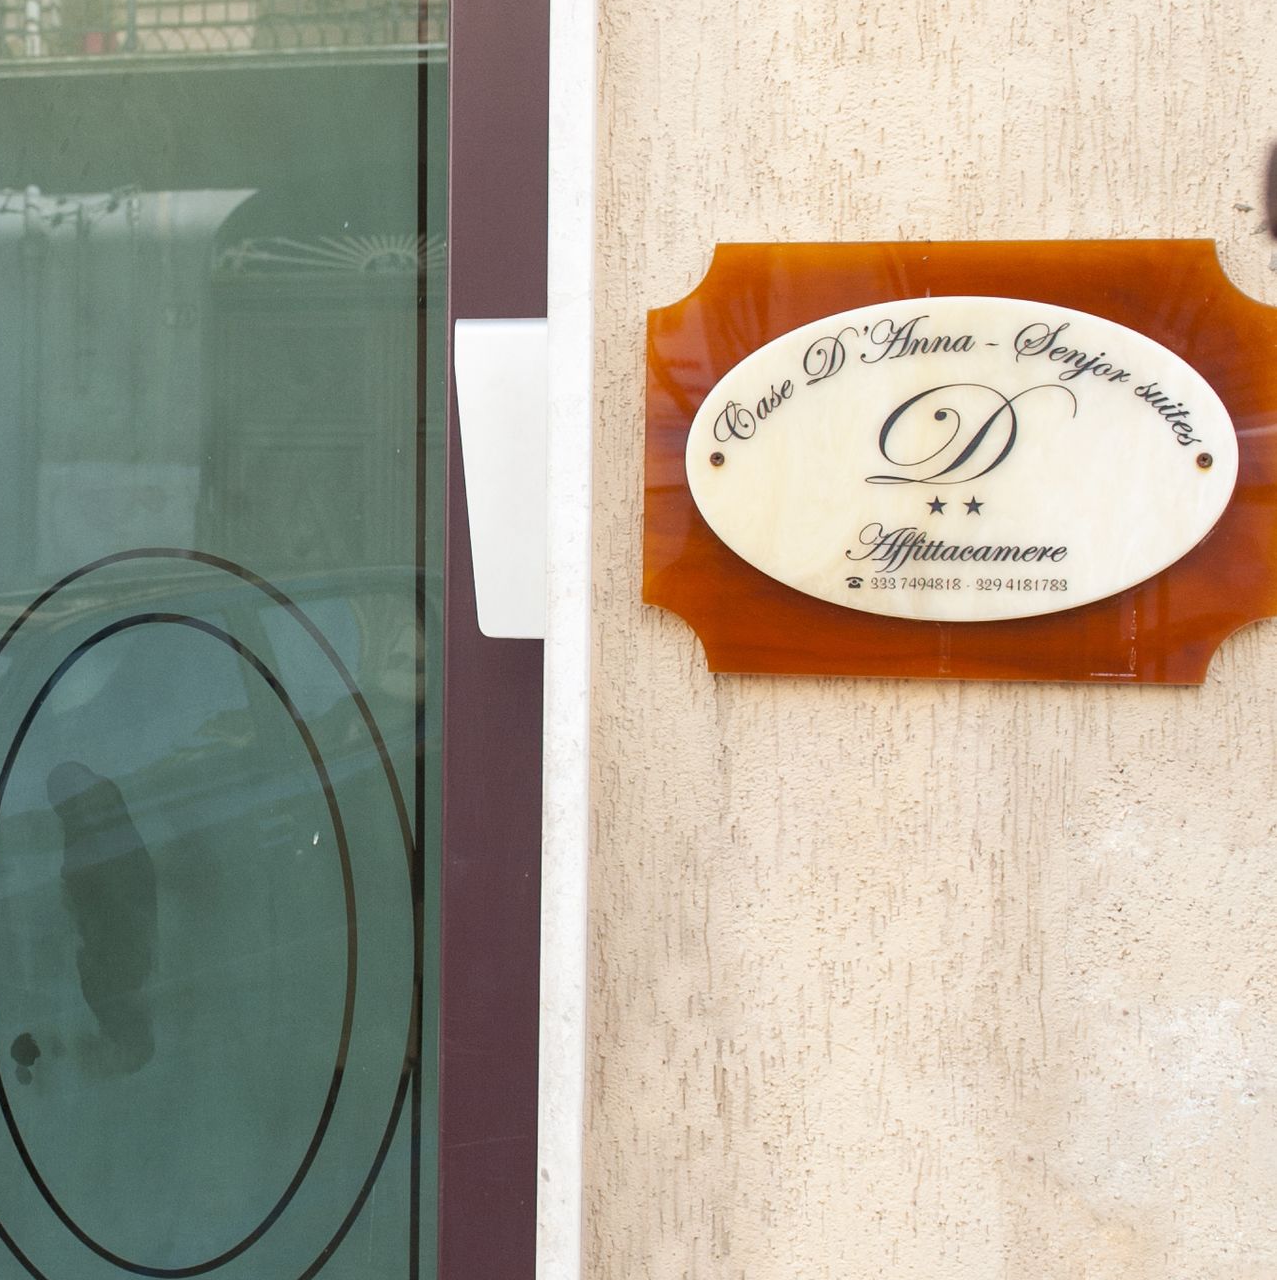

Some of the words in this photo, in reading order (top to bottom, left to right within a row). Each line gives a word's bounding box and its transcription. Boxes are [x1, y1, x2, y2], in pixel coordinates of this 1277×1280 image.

[713, 378, 794, 443] Case
[803, 315, 976, 386] D'Anna
[1134, 381, 1202, 447] suites
[864, 382, 1078, 485] D
[845, 522, 1068, 574] Affittacamere
[870, 578, 897, 590] 333
[901, 578, 961, 591] 7494818
